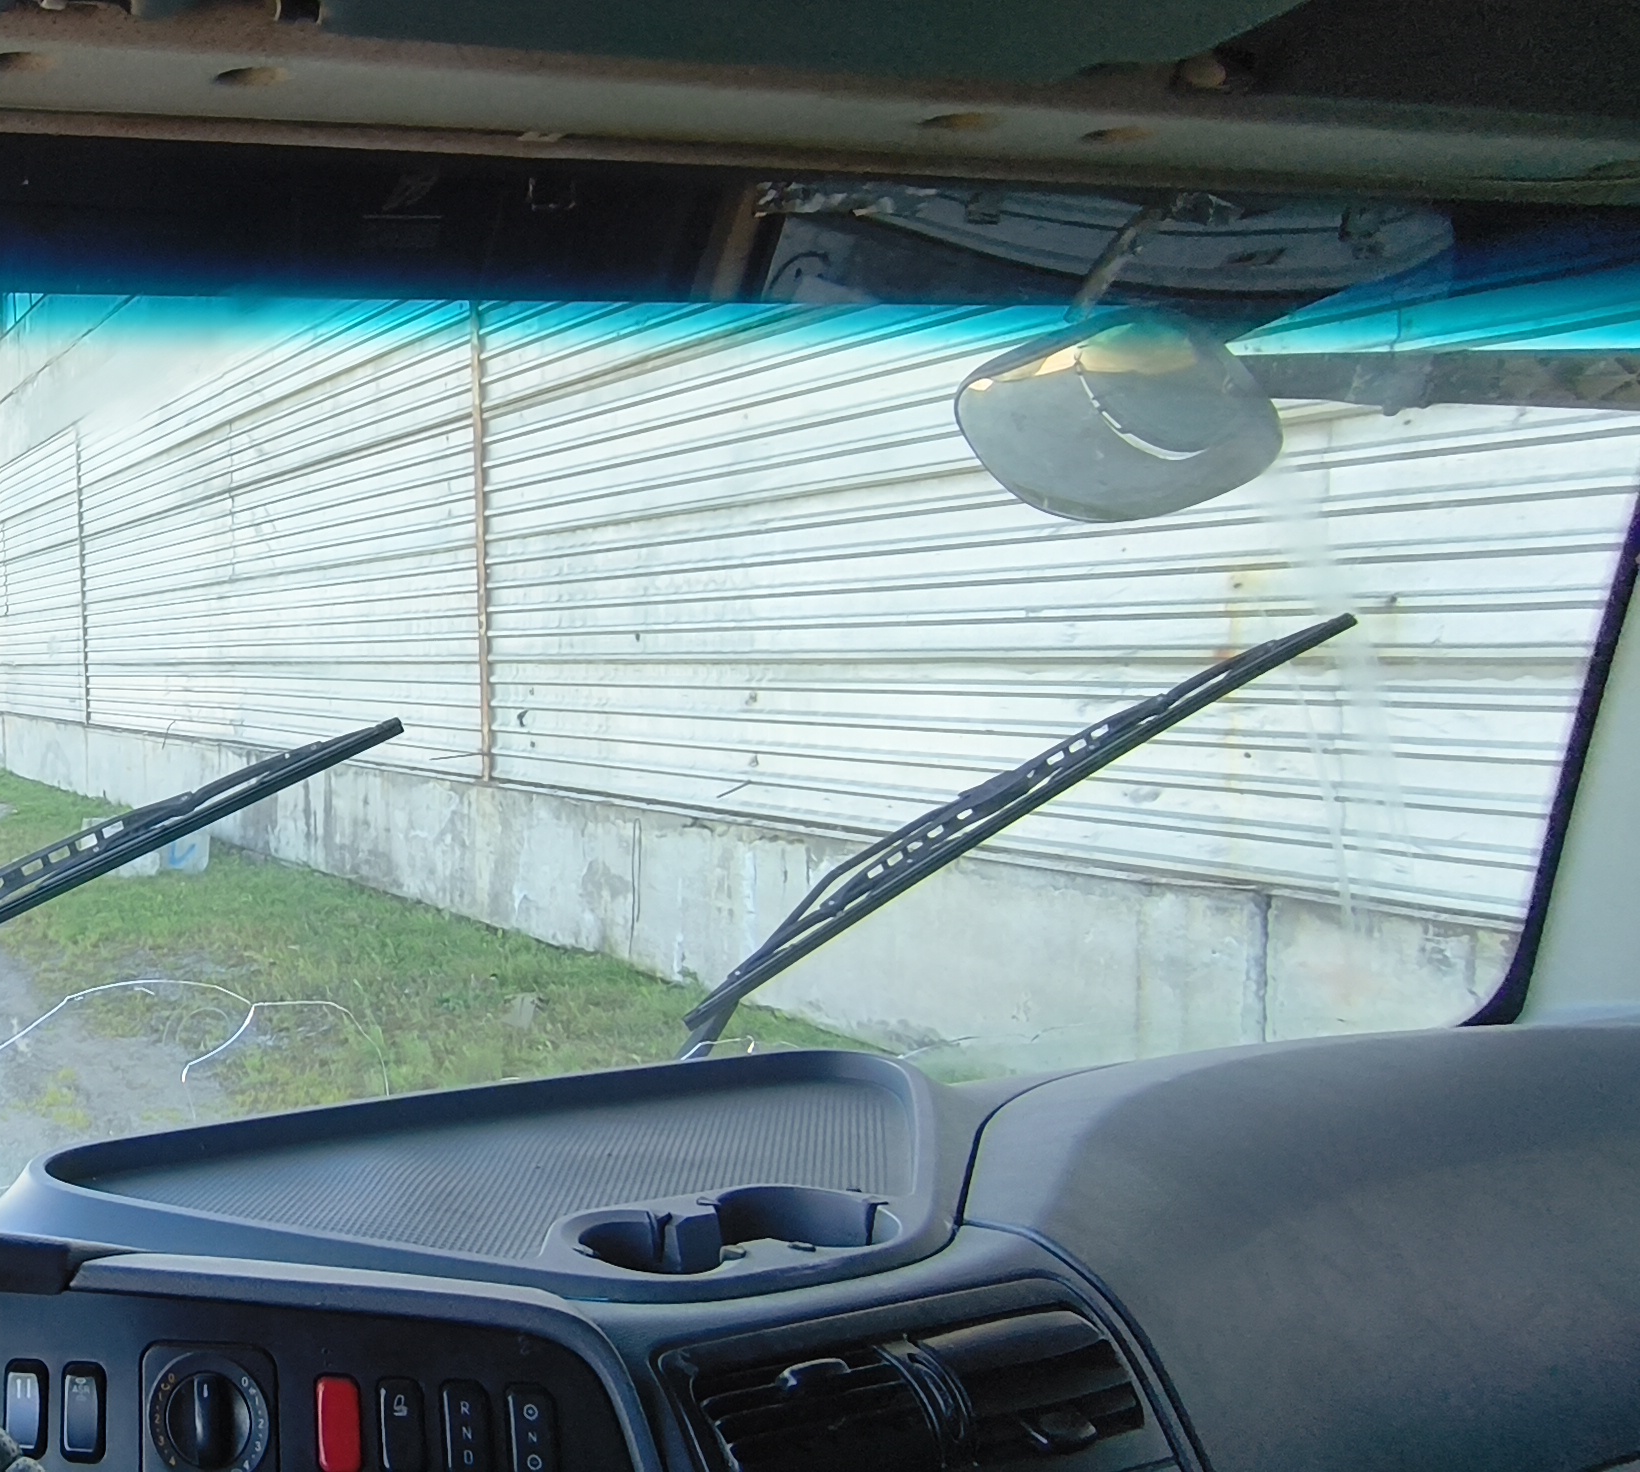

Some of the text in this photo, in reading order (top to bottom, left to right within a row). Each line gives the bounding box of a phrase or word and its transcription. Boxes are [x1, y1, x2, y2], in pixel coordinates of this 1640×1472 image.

[241, 1376, 249, 1388] 0
[71, 1384, 91, 1394] ASR
[460, 1401, 470, 1416] R
[154, 1413, 161, 1424] 2
[258, 1418, 265, 1429] 2
[462, 1426, 473, 1440] N
[528, 1431, 538, 1443] N
[158, 1435, 165, 1447] 3
[255, 1440, 262, 1452] 3
[242, 1460, 251, 1471] 4
